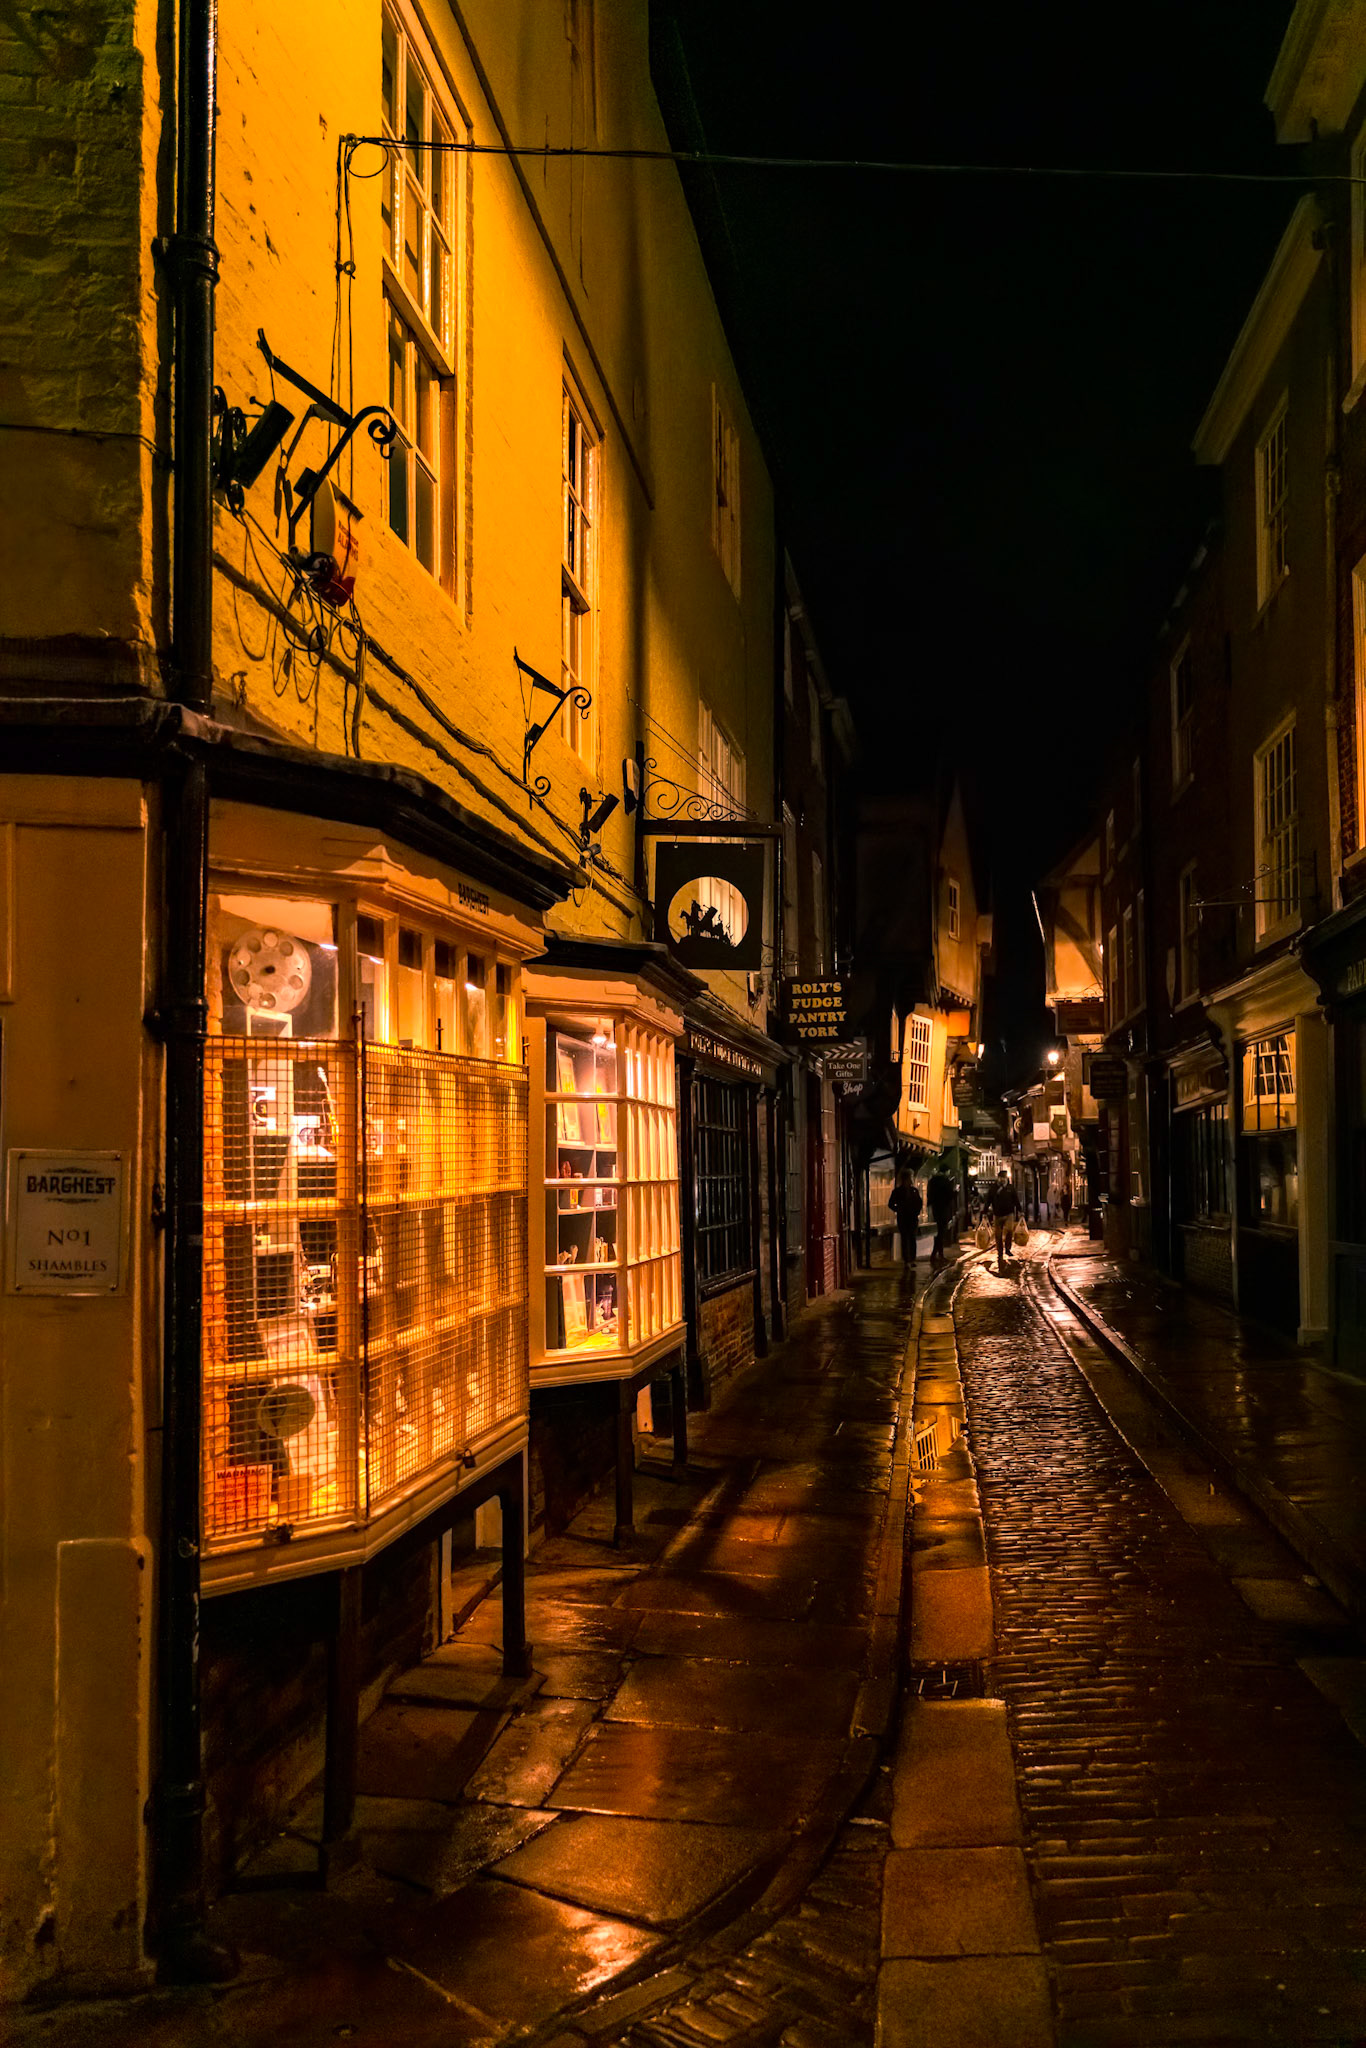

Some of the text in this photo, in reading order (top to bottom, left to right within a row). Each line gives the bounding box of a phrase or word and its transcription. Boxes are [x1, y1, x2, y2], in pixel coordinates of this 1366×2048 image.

[792, 982, 842, 994] ROLY'S
[792, 997, 842, 1009] FUDGE
[788, 1011, 847, 1023] PANTRY
[798, 1026, 839, 1038] YORK
[828, 1062, 845, 1070] Take
[835, 1070, 853, 1078] Gifts
[843, 1081, 863, 1096] Shop
[27, 1176, 116, 1194] BARGHEST
[29, 1259, 107, 1272] SHAMBLES
[217, 1468, 266, 1479] WARNING
